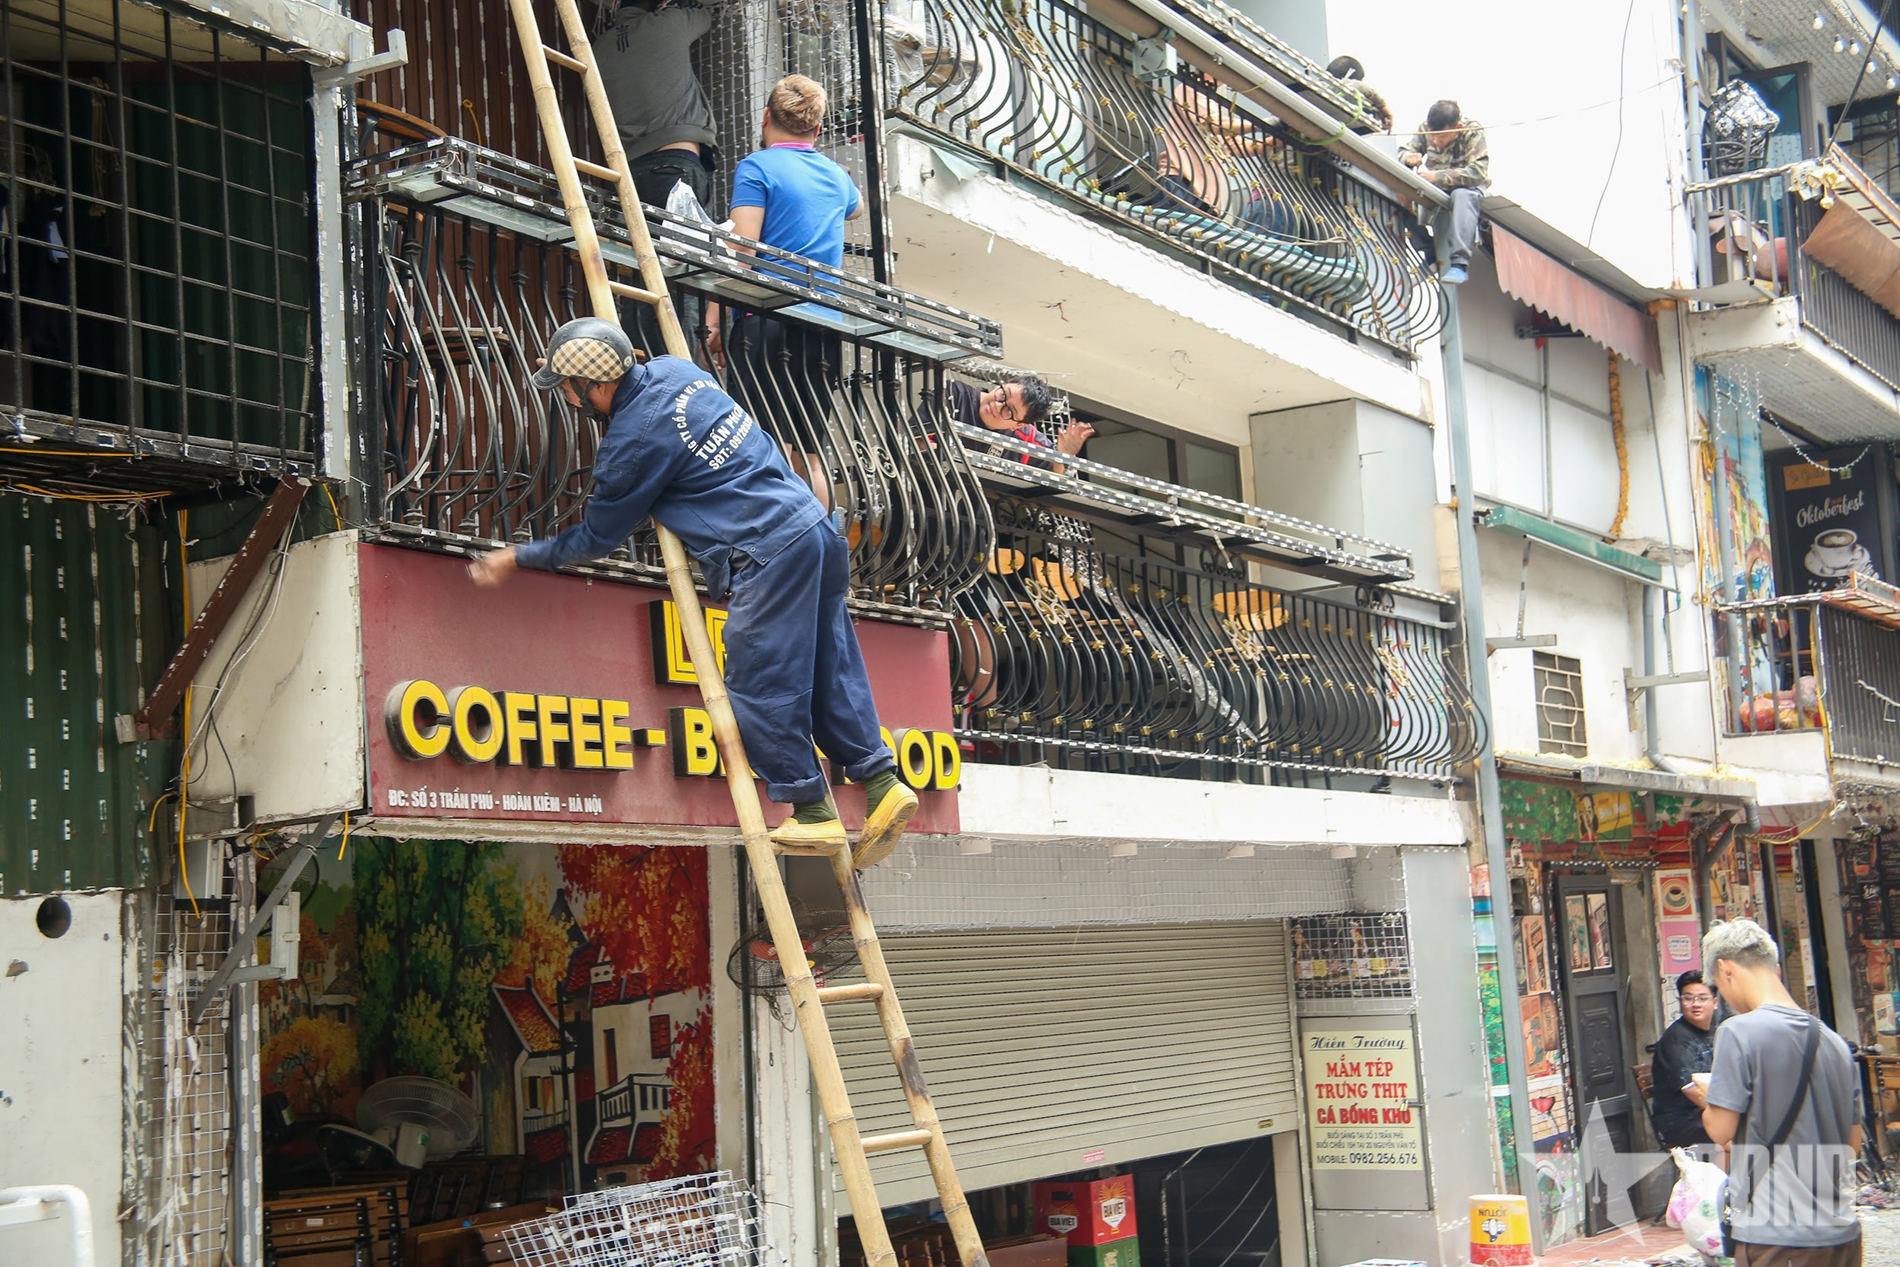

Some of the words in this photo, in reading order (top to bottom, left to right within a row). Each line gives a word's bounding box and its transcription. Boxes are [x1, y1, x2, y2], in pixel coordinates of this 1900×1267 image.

[679, 430, 692, 443] TY
[695, 424, 731, 461] TUẤN
[708, 447, 734, 470] SĐT:
[1796, 490, 1865, 528] Oktoberfest
[385, 678, 634, 772] COFFEE
[411, 785, 428, 808] SỐ
[429, 791, 438, 808] 3
[470, 790, 494, 810] PHÚ
[502, 791, 533, 811] HOÀN
[568, 793, 584, 812] HÀ
[584, 793, 603, 816] NỘI
[1326, 1053, 1362, 1077] MẮM
[1365, 1057, 1394, 1077] TÉP
[1371, 1082, 1408, 1103] THỊT
[1317, 1105, 1337, 1125] CÁ
[1349, 1152, 1418, 1165] 0982.256.676
[1049, 1217, 1062, 1226] BIA
